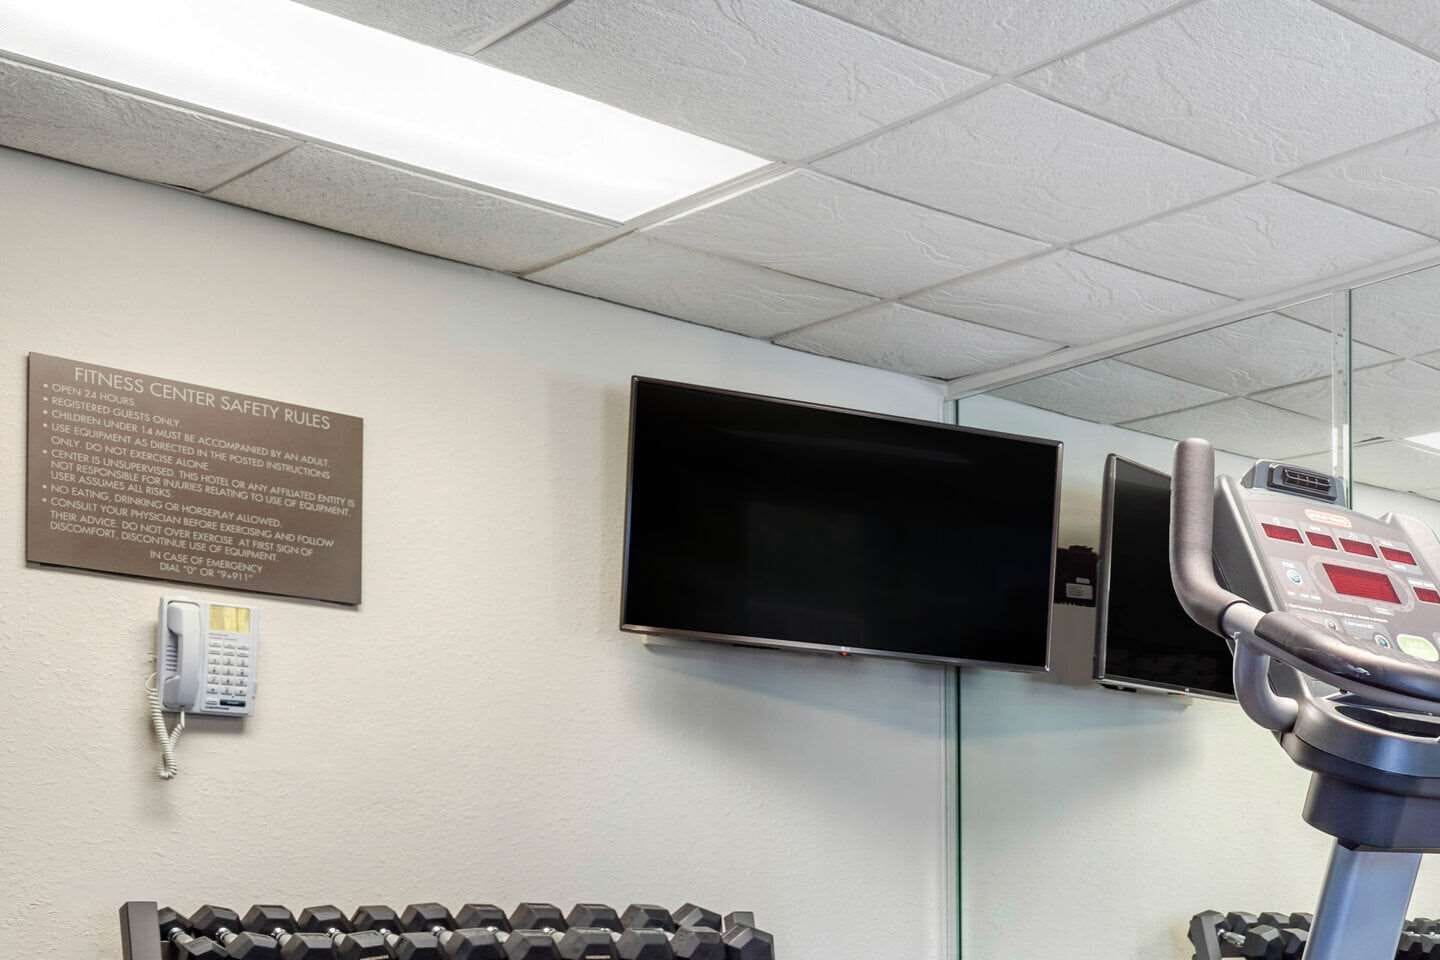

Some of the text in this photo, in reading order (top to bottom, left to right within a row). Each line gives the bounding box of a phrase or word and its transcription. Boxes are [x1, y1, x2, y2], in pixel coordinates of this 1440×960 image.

[52, 383, 81, 395] OPEN
[85, 389, 97, 399] 24
[52, 396, 110, 414] REGISTERED
[112, 408, 149, 422] GUESTS
[74, 367, 331, 430] FITNESS CENTER SAFETY RULES
[52, 409, 100, 426] CHILDREN
[103, 420, 138, 433] UNDER
[142, 425, 153, 435] 14
[156, 428, 182, 441] MUST
[184, 433, 197, 443] BE
[199, 436, 269, 456] ACCOMPANIED
[270, 449, 282, 458] BY
[285, 451, 299, 461] AN
[52, 423, 331, 480] USE EQUIPMENT AS DIRECTED IN THE POSTED INSTRUCTIONS
[86, 442, 103, 452] DO
[105, 444, 127, 456] NOT
[130, 447, 173, 464] EXERCISE
[51, 449, 89, 463] CENTER
[91, 456, 100, 465] IS
[179, 470, 199, 482] THIS
[201, 474, 229, 487] HOTEL
[231, 480, 245, 490] OR
[248, 482, 268, 494] ANY
[270, 486, 316, 500] AFFILIATED
[318, 493, 346, 506] ENTITY
[348, 499, 356, 508] IS
[51, 471, 75, 483] USER
[79, 475, 125, 491] ASSUMES
[127, 483, 143, 494] ALL
[51, 460, 73, 472] NOT
[76, 464, 140, 482] RESPONSIBLE
[142, 474, 161, 486] FOR
[163, 478, 202, 493] INJURIES
[205, 485, 249, 500] RELATING
[251, 492, 264, 503] TO
[266, 496, 283, 506] USE
[285, 499, 297, 508] OF
[51, 484, 69, 494] NO
[115, 494, 163, 510] DRINKING
[164, 502, 180, 511] OR
[181, 504, 235, 520] HORSEPLAY
[50, 497, 335, 547] CONSULT YOUR PHYSICIAN BEFORE EXERCISING AND FOLLOW
[50, 510, 77, 521] THEIR
[121, 521, 138, 531] DO
[140, 523, 162, 534] NOT
[164, 527, 190, 539] OVER
[238, 538, 251, 548] AT
[252, 540, 274, 551] FIRST
[275, 543, 299, 555] SIGN
[300, 547, 314, 557] OF
[121, 531, 188, 549] DISCONTINUE
[189, 541, 207, 552] USE
[209, 544, 222, 553] OF
[150, 550, 263, 574] IN CASE OF EMERGENCY
[159, 561, 179, 574] DIAL
[200, 568, 214, 577] OR
